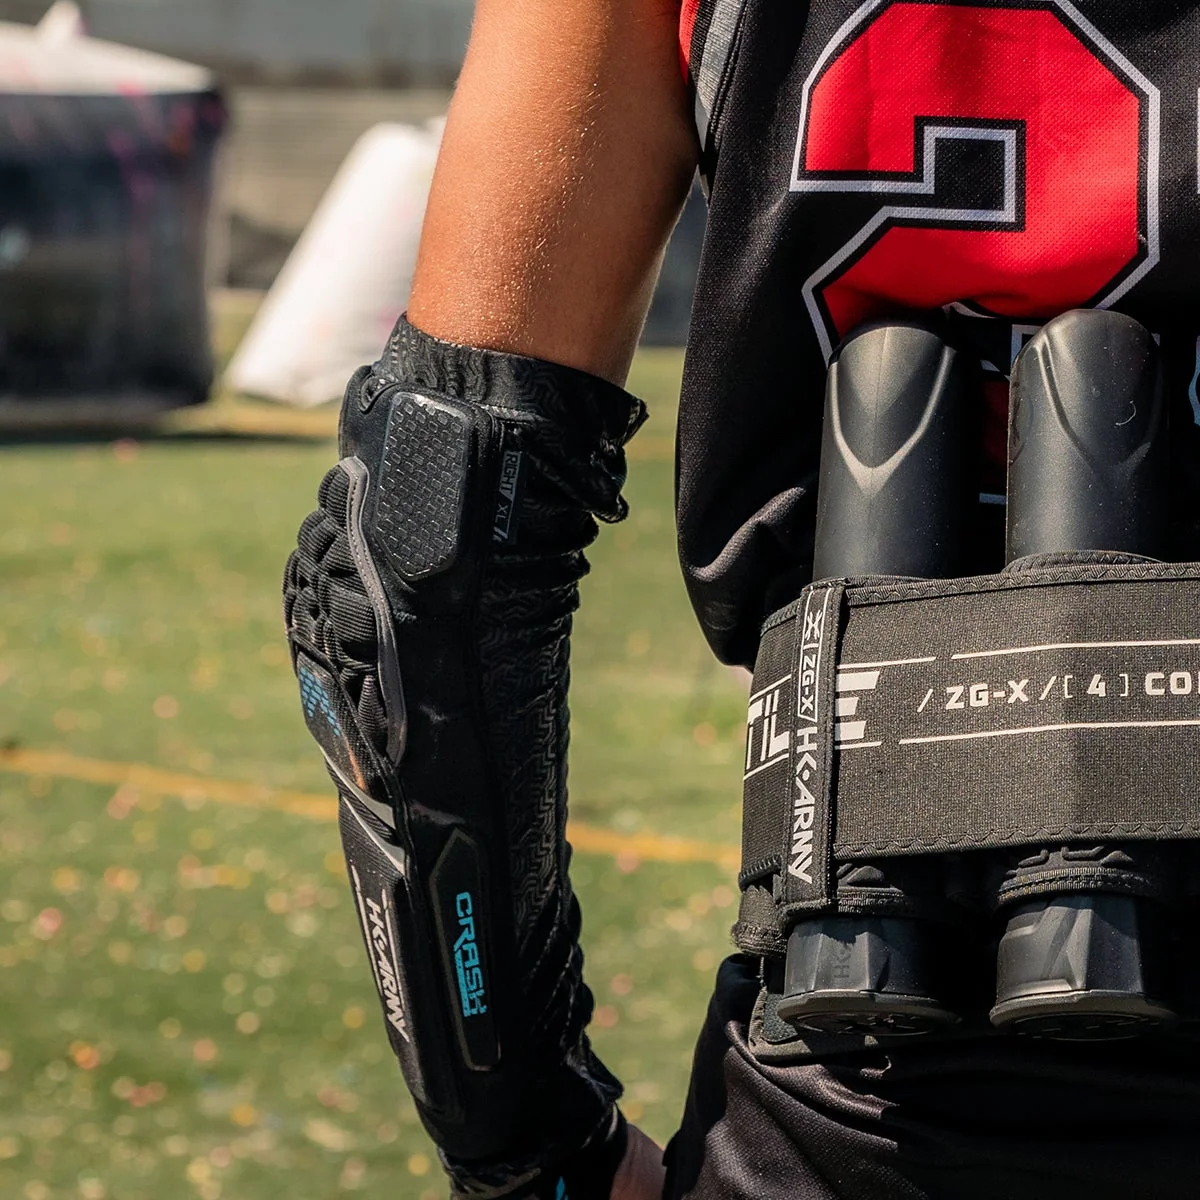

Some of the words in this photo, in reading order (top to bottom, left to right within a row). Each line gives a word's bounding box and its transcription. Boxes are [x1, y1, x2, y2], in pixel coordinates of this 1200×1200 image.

[501, 454, 518, 495] RIGHT
[801, 654, 817, 713] ZG-X
[945, 679, 1030, 711] ZG-X
[454, 891, 488, 1018] CRASH
